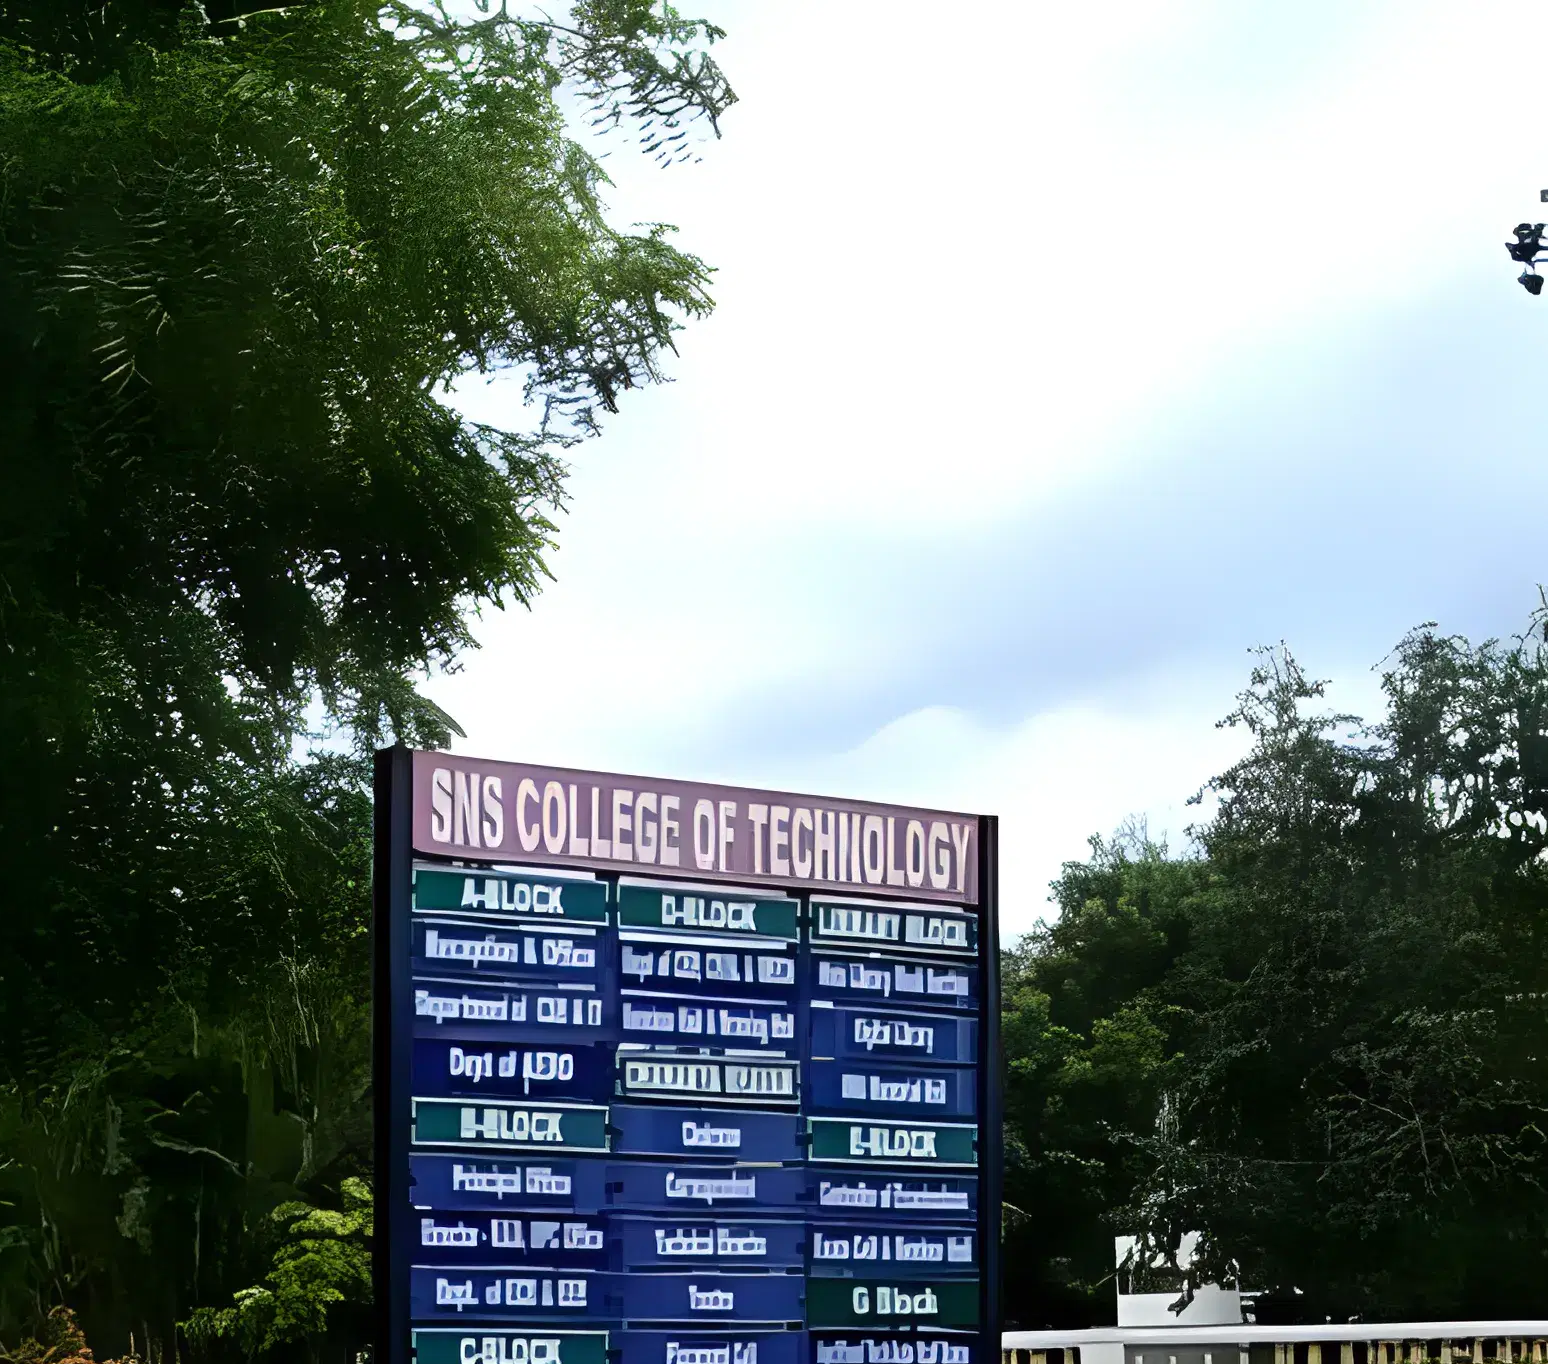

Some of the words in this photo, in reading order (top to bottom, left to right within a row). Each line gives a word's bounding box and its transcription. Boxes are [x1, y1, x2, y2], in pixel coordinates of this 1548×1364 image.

[431, 768, 504, 848] SNS
[516, 778, 680, 866] COLLEGE
[693, 799, 736, 872] OF
